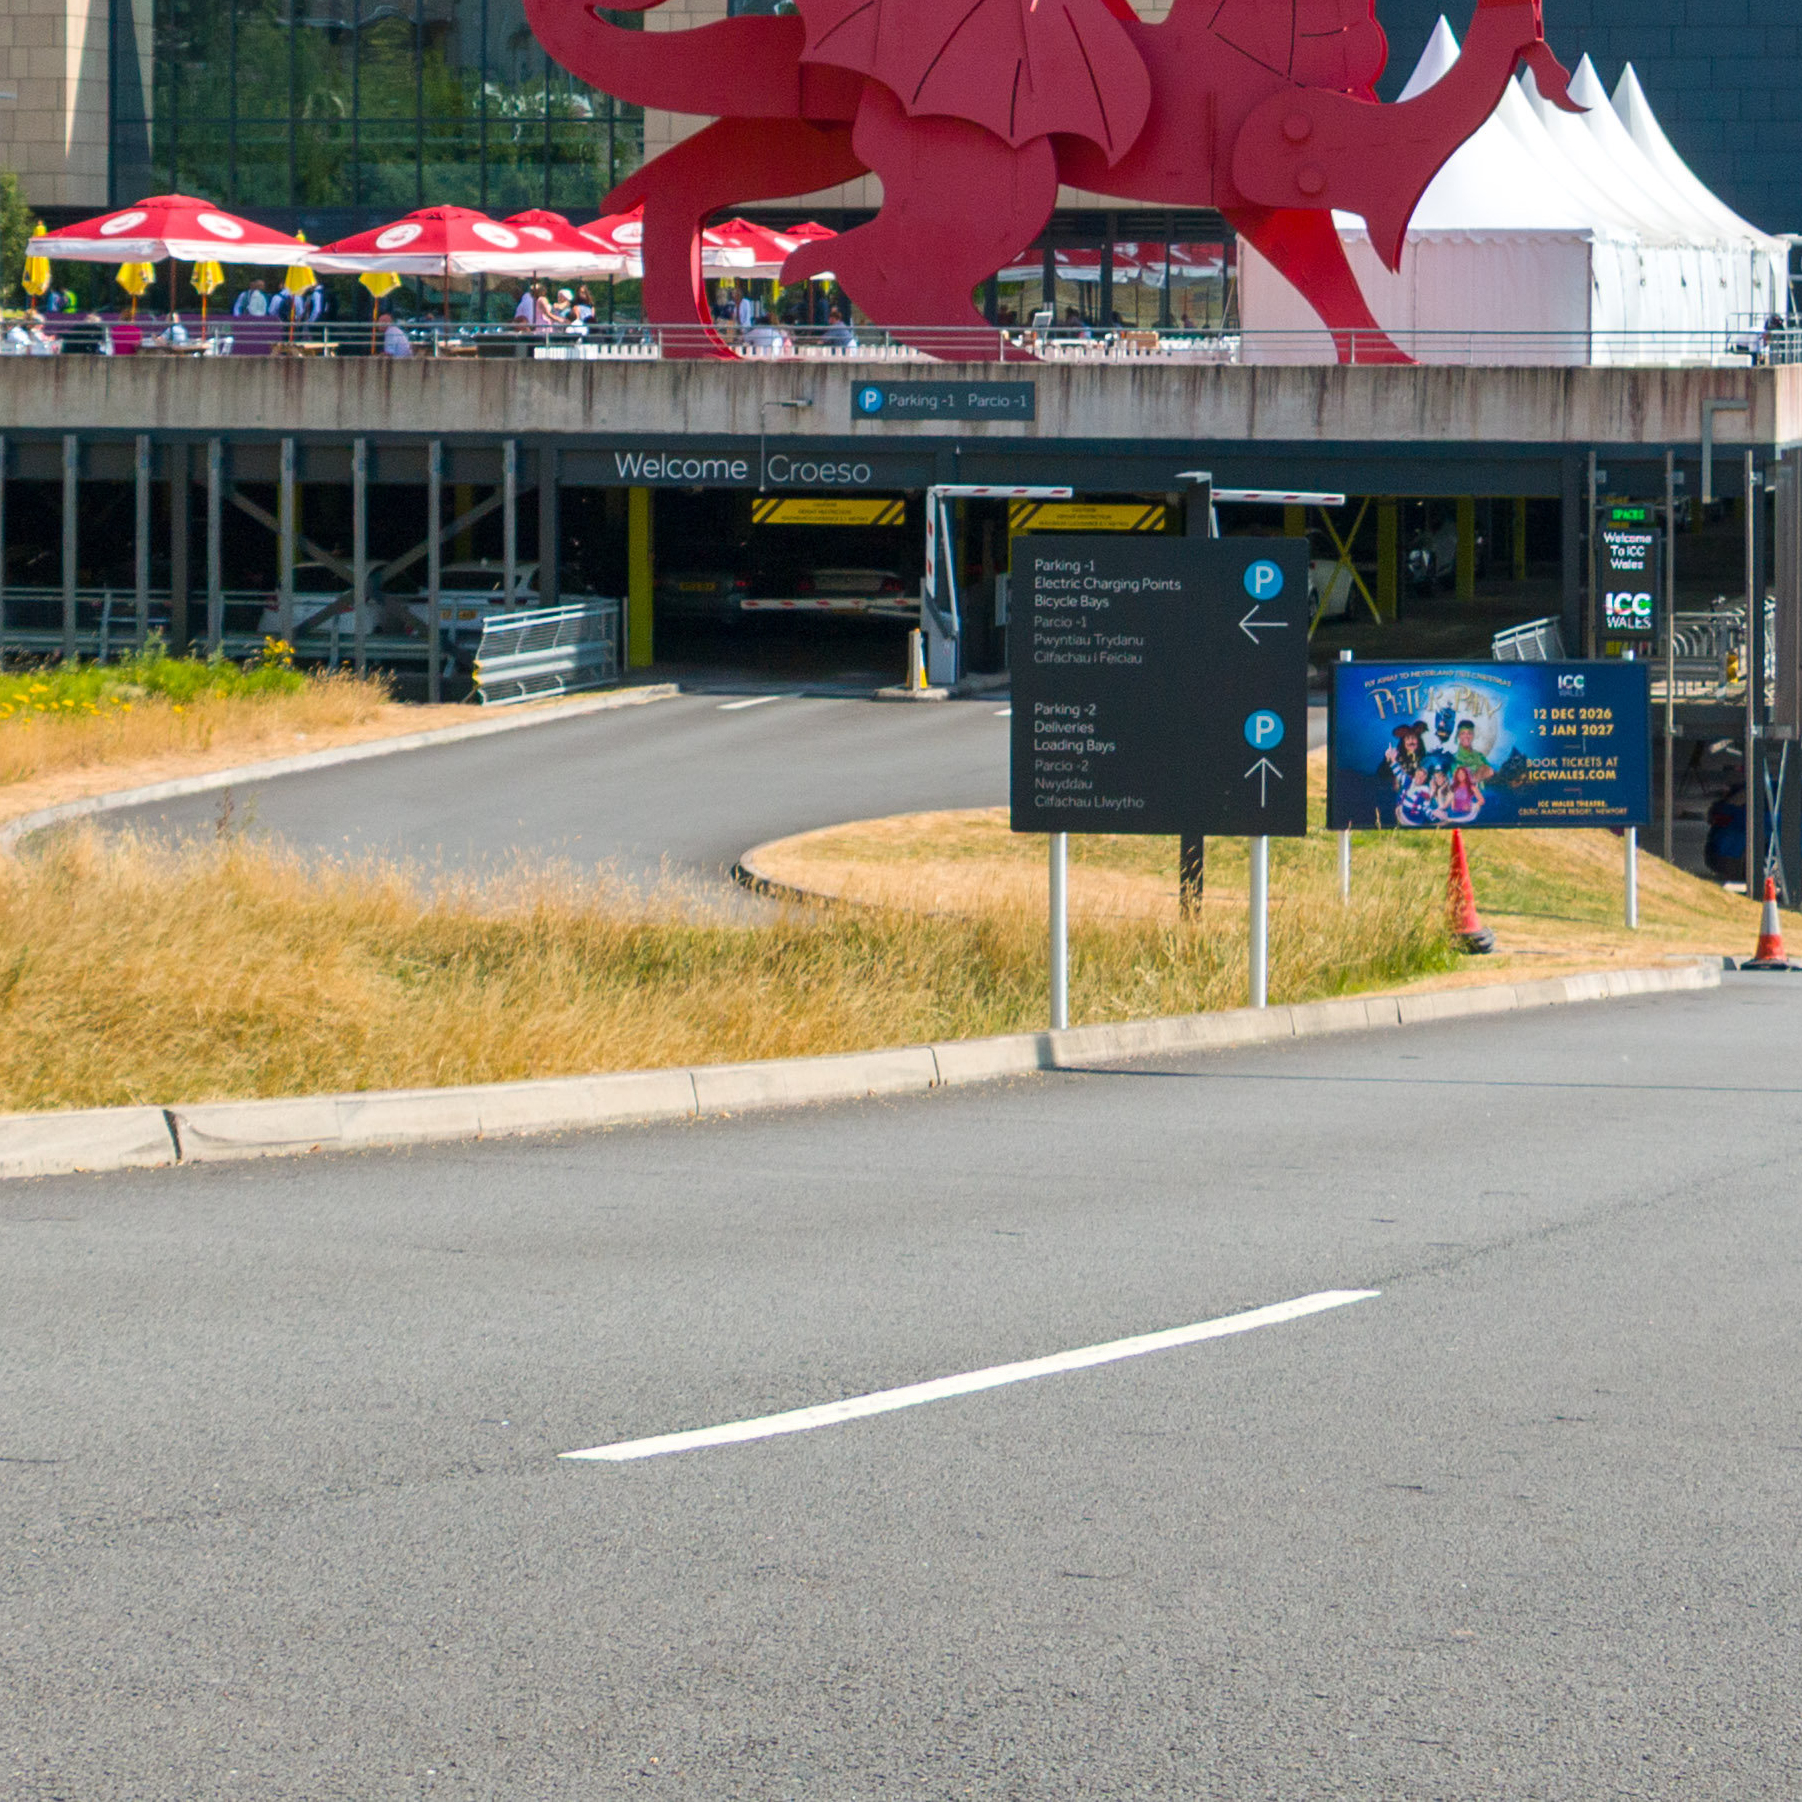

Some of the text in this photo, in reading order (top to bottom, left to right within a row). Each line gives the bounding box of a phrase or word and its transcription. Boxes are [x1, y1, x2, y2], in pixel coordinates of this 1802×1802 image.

[865, 391, 1027, 411] P Parking -1 Parcio -1
[614, 452, 871, 484] Welcome Croeso
[1612, 508, 1646, 521] SPACES
[1603, 531, 1653, 544] Welcome
[1610, 545, 1646, 557] To ICC
[1034, 558, 1095, 575] Parking -1
[1610, 558, 1644, 570] Wales
[1034, 576, 1182, 593] Electric Charging Points
[1255, 565, 1275, 594] P
[1034, 594, 1110, 610] Bicycle Bays
[1605, 592, 1652, 616] ICC
[1034, 615, 1087, 628] Parcio -1
[1606, 616, 1652, 629] WALES
[1034, 633, 1144, 648] Pwyntiau Trydanu
[1034, 650, 1091, 664] Cilfachau
[1099, 651, 1143, 664] Feiciau
[1558, 674, 1585, 690] ICC
[1034, 702, 1097, 718] Parking -2
[1533, 708, 1613, 720] 12 DEC 2026
[1034, 720, 1095, 734] Deliveries
[1255, 715, 1275, 744] P
[1538, 724, 1547, 736] 2
[1551, 724, 1577, 736] JAN
[1581, 724, 1614, 736] 2027
[1034, 738, 1116, 755] Loading Bays
[1034, 759, 1089, 772] Parcio -2
[1526, 756, 1619, 768] BOOK TICKETS AT
[1528, 770, 1617, 781] ICCWALES.COM
[1034, 777, 1093, 793] Nwyddau
[1034, 794, 1145, 811] Cilfachau Llwytho
